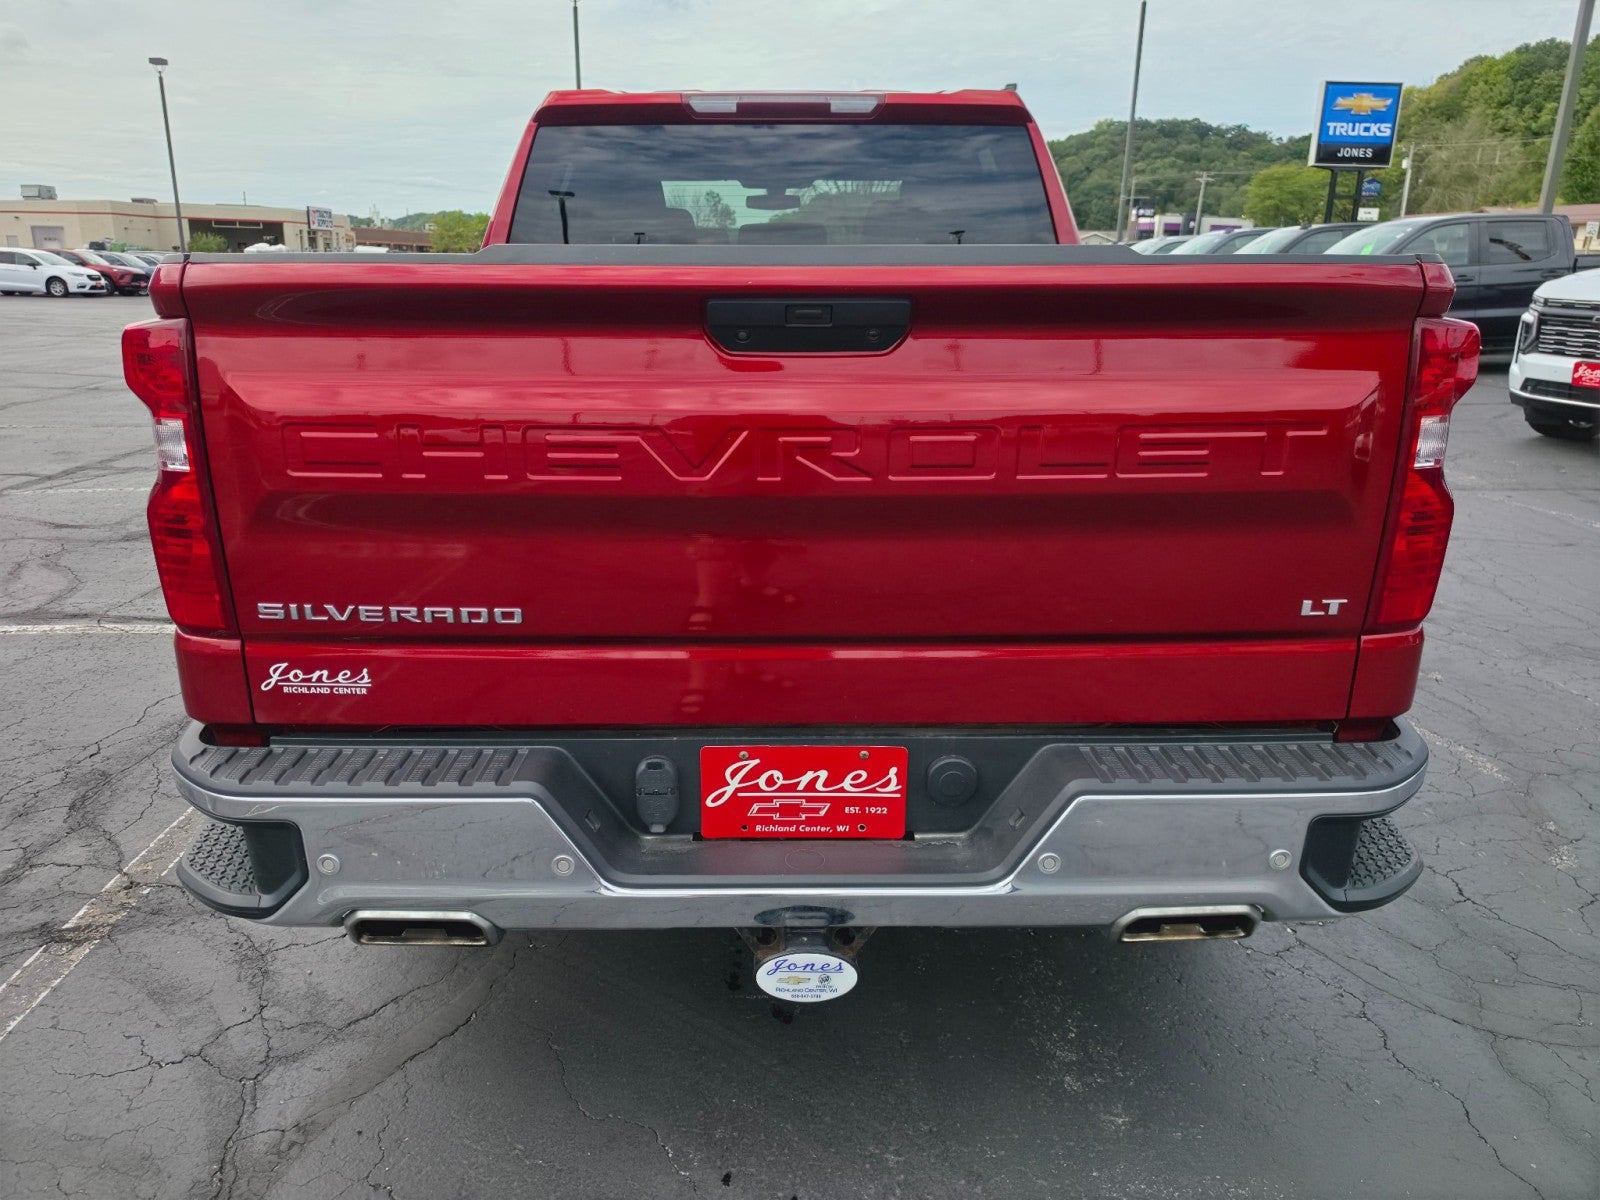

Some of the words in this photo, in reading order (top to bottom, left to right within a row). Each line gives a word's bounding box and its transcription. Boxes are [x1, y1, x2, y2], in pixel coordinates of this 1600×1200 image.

[1326, 122, 1392, 137] TRUCKS
[1336, 147, 1373, 158] JONES
[281, 421, 1328, 482] CHEVROLET
[257, 602, 523, 624] SILVERADO
[1300, 598, 1348, 616] LT
[260, 662, 372, 691] Jones
[283, 686, 330, 694] RICHLAND
[333, 686, 367, 695] CENTER
[705, 758, 902, 808] Jones
[844, 806, 861, 814] EST.
[865, 806, 888, 814] 1922
[755, 824, 796, 832] Richland
[799, 824, 833, 833] Center,
[766, 959, 844, 976] Jones
